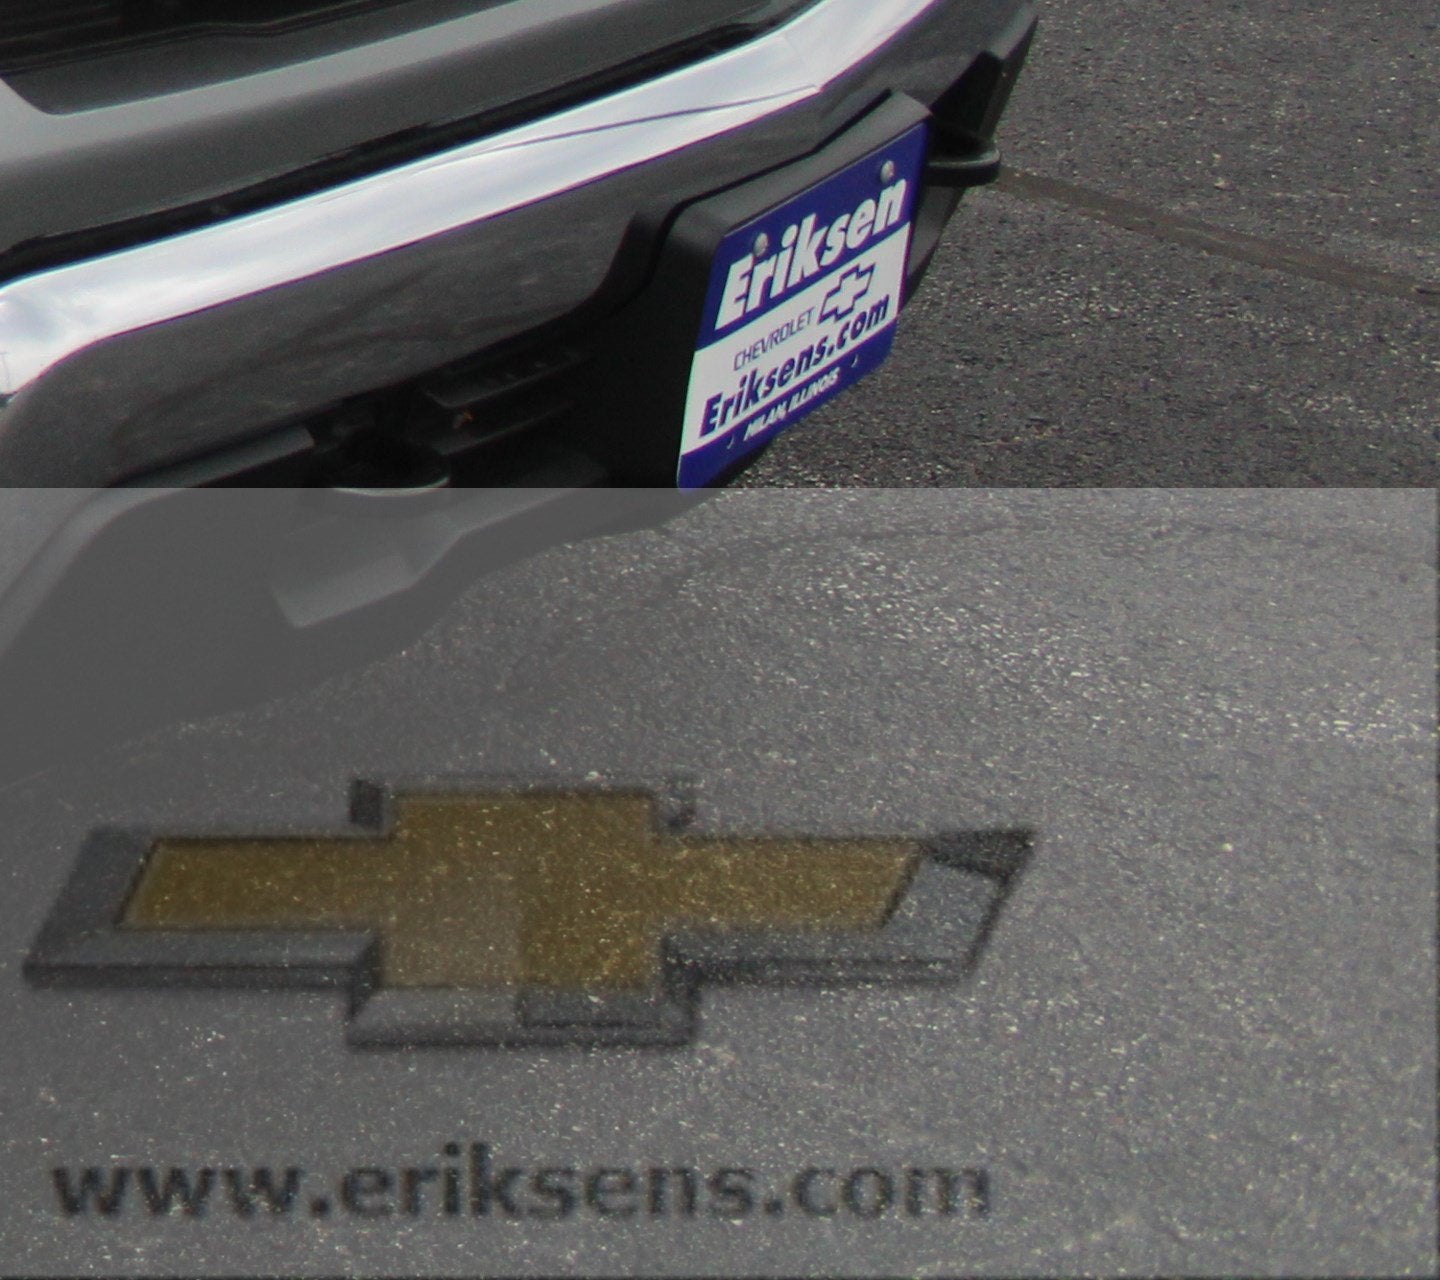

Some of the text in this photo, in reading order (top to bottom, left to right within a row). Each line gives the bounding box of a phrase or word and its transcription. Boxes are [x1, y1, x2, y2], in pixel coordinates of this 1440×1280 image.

[714, 179, 907, 331] Eriksen
[699, 294, 890, 437] Eriksens.com
[733, 306, 815, 372] CHEVROLET
